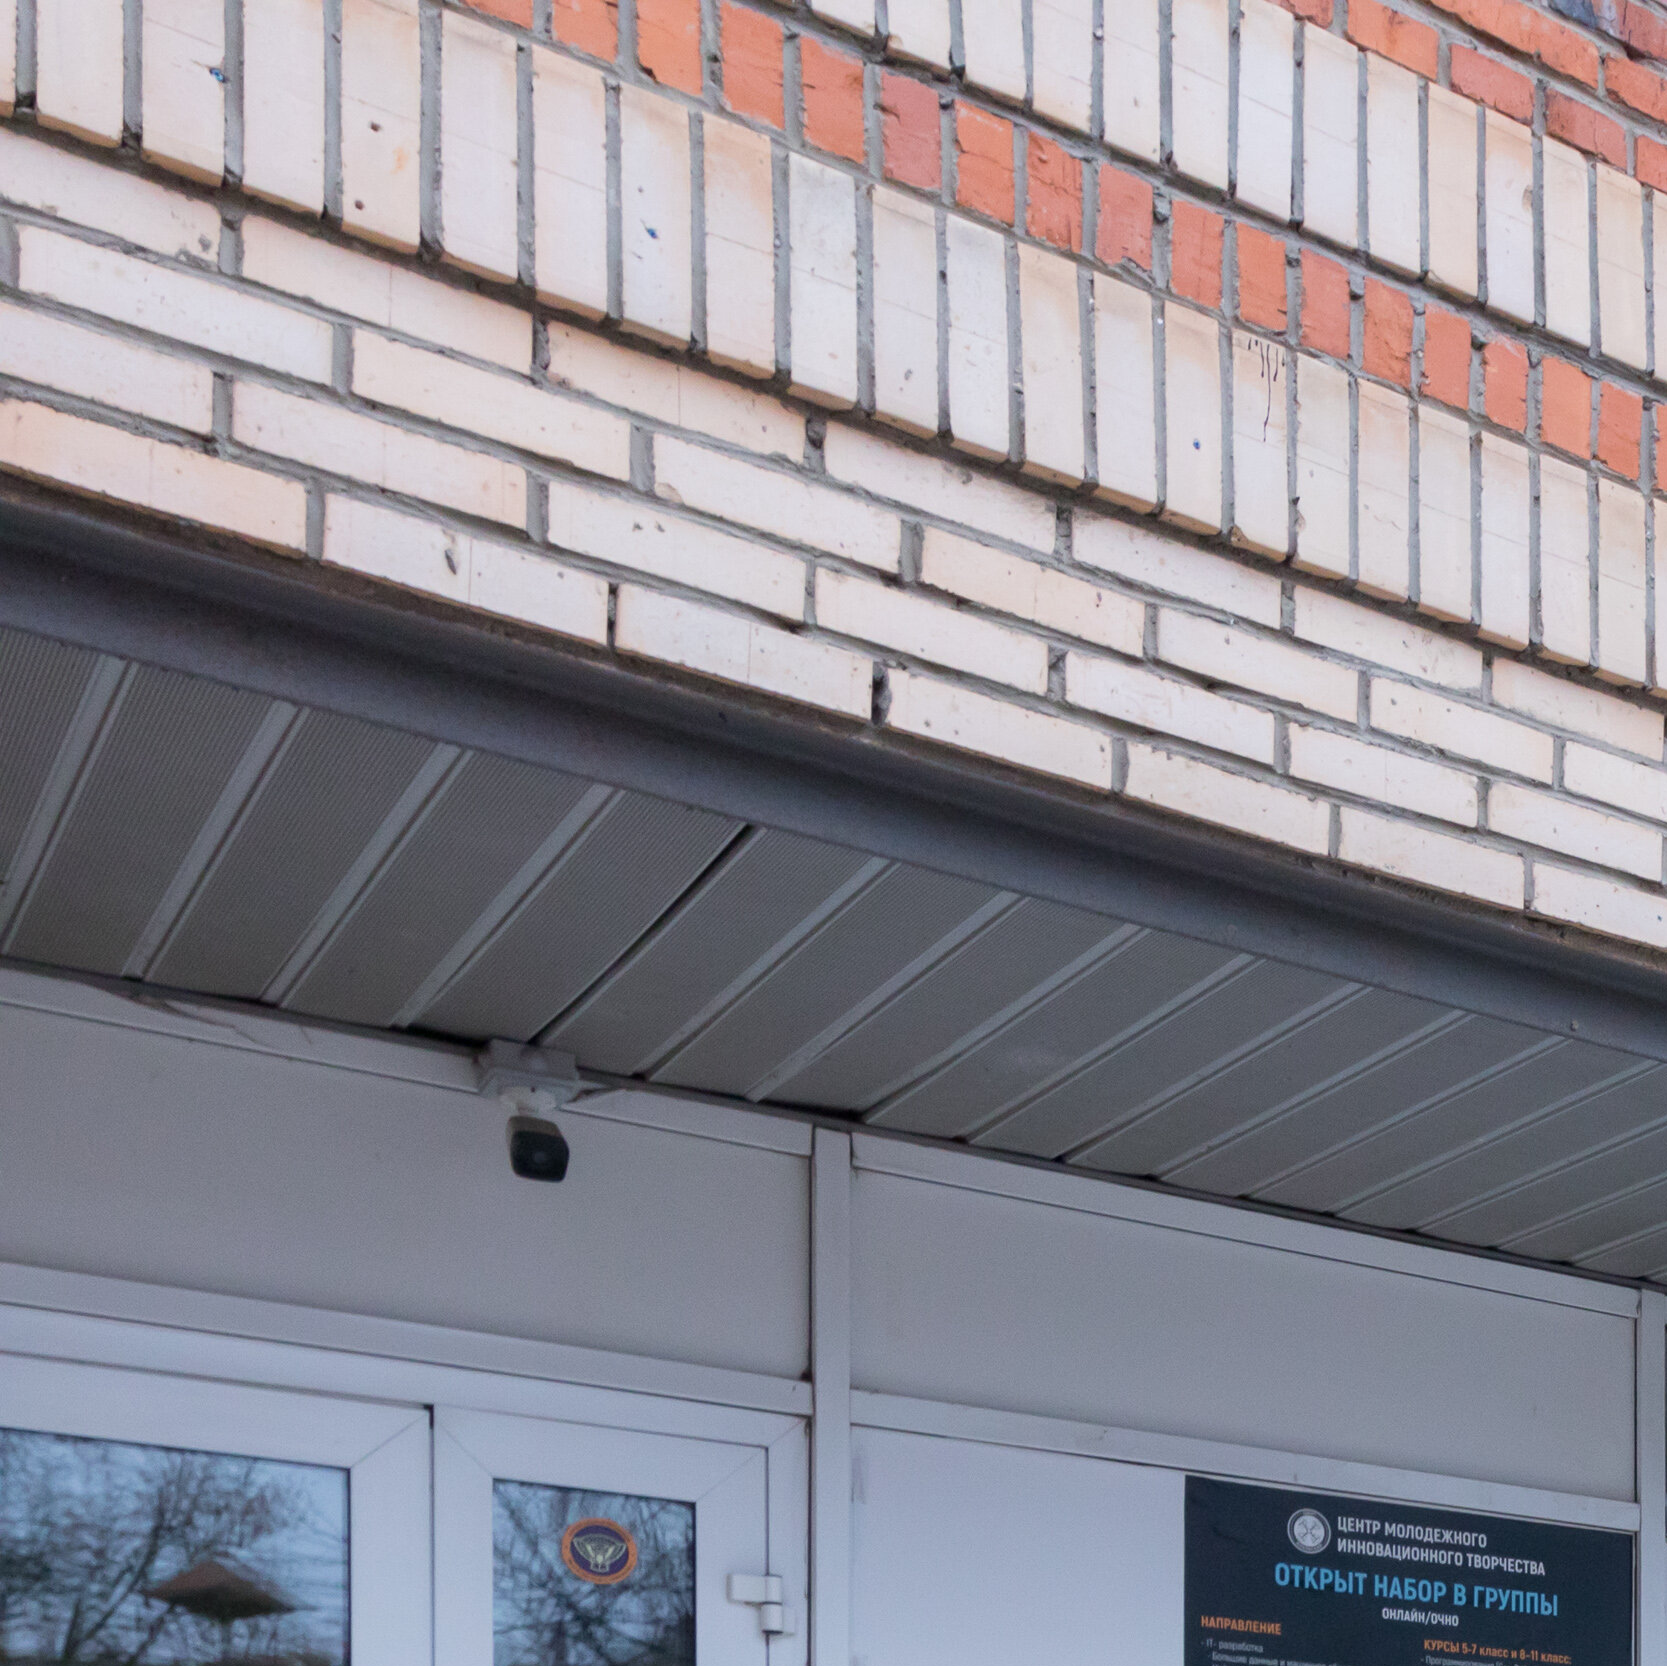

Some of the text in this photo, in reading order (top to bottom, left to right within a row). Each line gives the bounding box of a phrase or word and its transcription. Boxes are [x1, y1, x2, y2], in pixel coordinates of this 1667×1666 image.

[1337, 1515, 1381, 1535] ЦЕНТР
[1384, 1521, 1487, 1548] МОЛОДЕЖНОГО
[1337, 1537, 1546, 1576] ИННОВАЦИОННОГО ТВОРЧЕСТВА
[1274, 1561, 1558, 1617] ОТКРЫТ НАБОР В ГРУППЫ
[1200, 1615, 1281, 1635] НАПРАВЛЕНИЕ
[1381, 1606, 1459, 1627] ОНЛАЙН/ОЧНО
[1217, 1640, 1264, 1653] разработка
[1423, 1639, 1571, 1664] КУРСЫ 5-7 класс и 8-11 класс:
